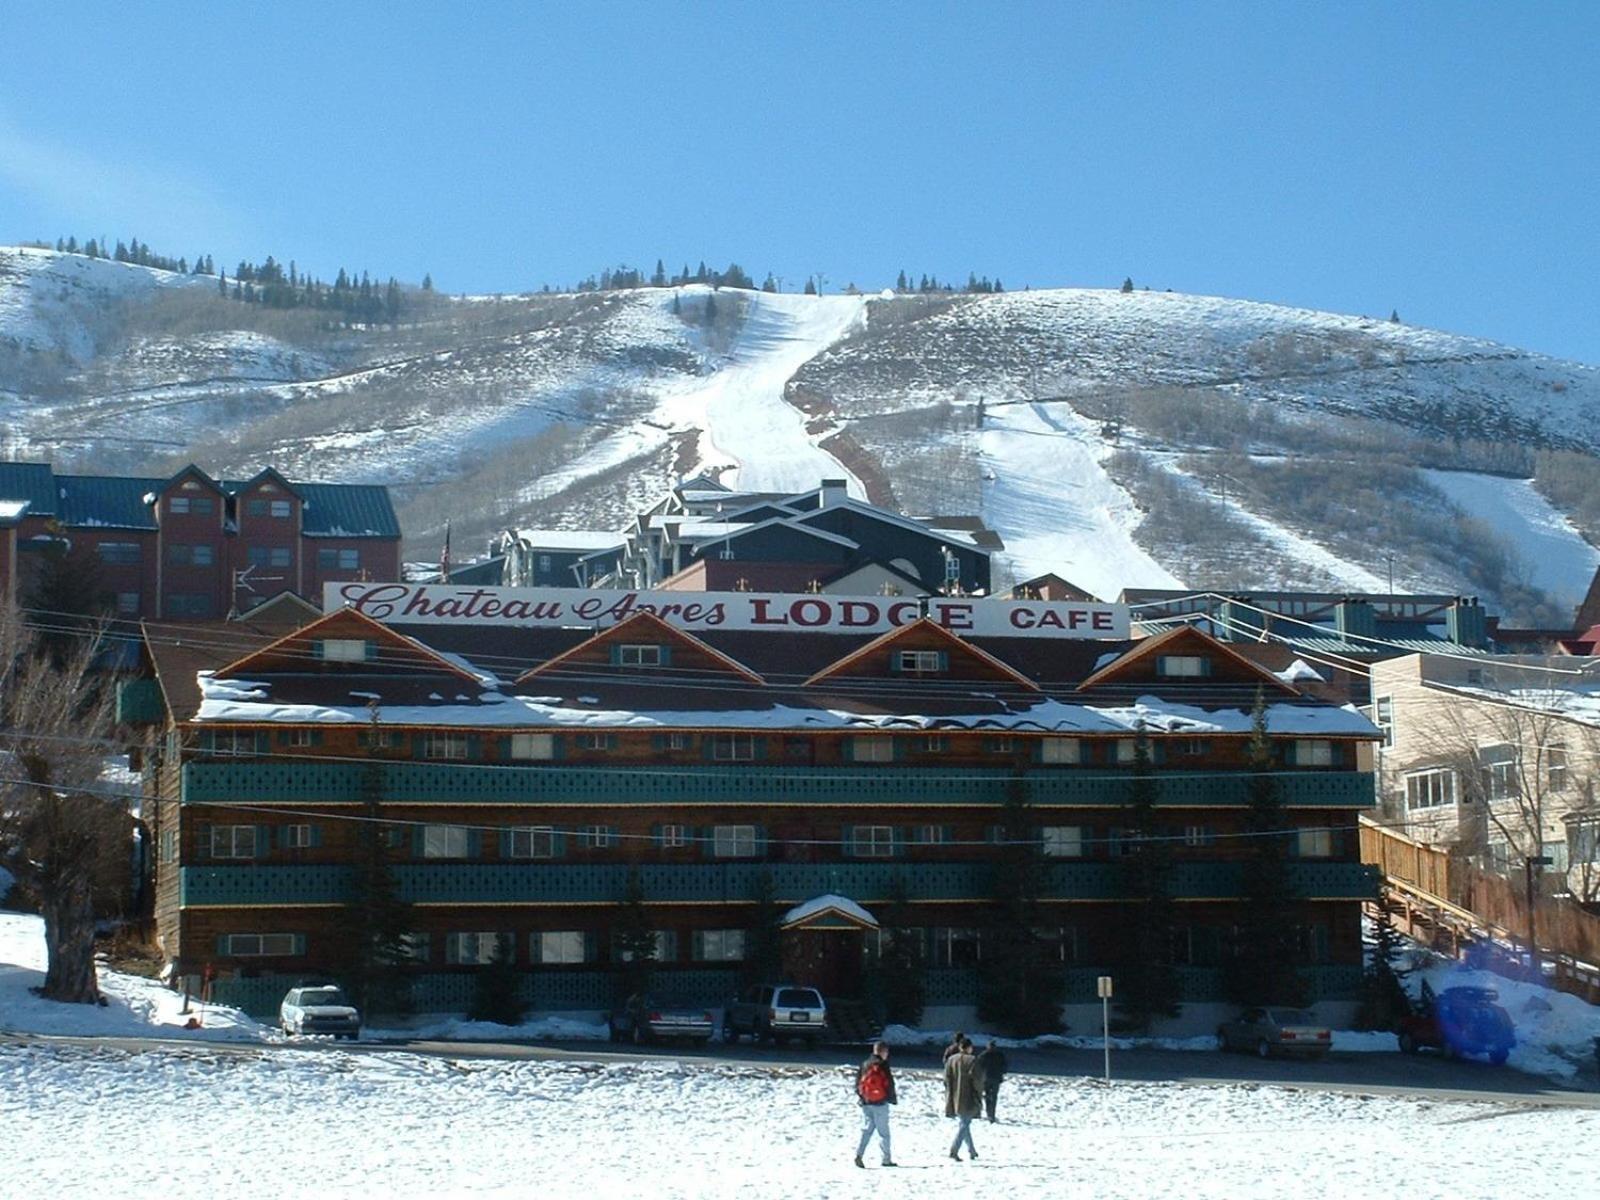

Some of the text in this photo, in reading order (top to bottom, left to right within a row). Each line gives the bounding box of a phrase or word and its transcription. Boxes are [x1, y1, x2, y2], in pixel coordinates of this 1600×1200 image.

[341, 584, 563, 619] Chateau
[749, 599, 974, 630] LODGE
[1009, 607, 1114, 630] CAFE
